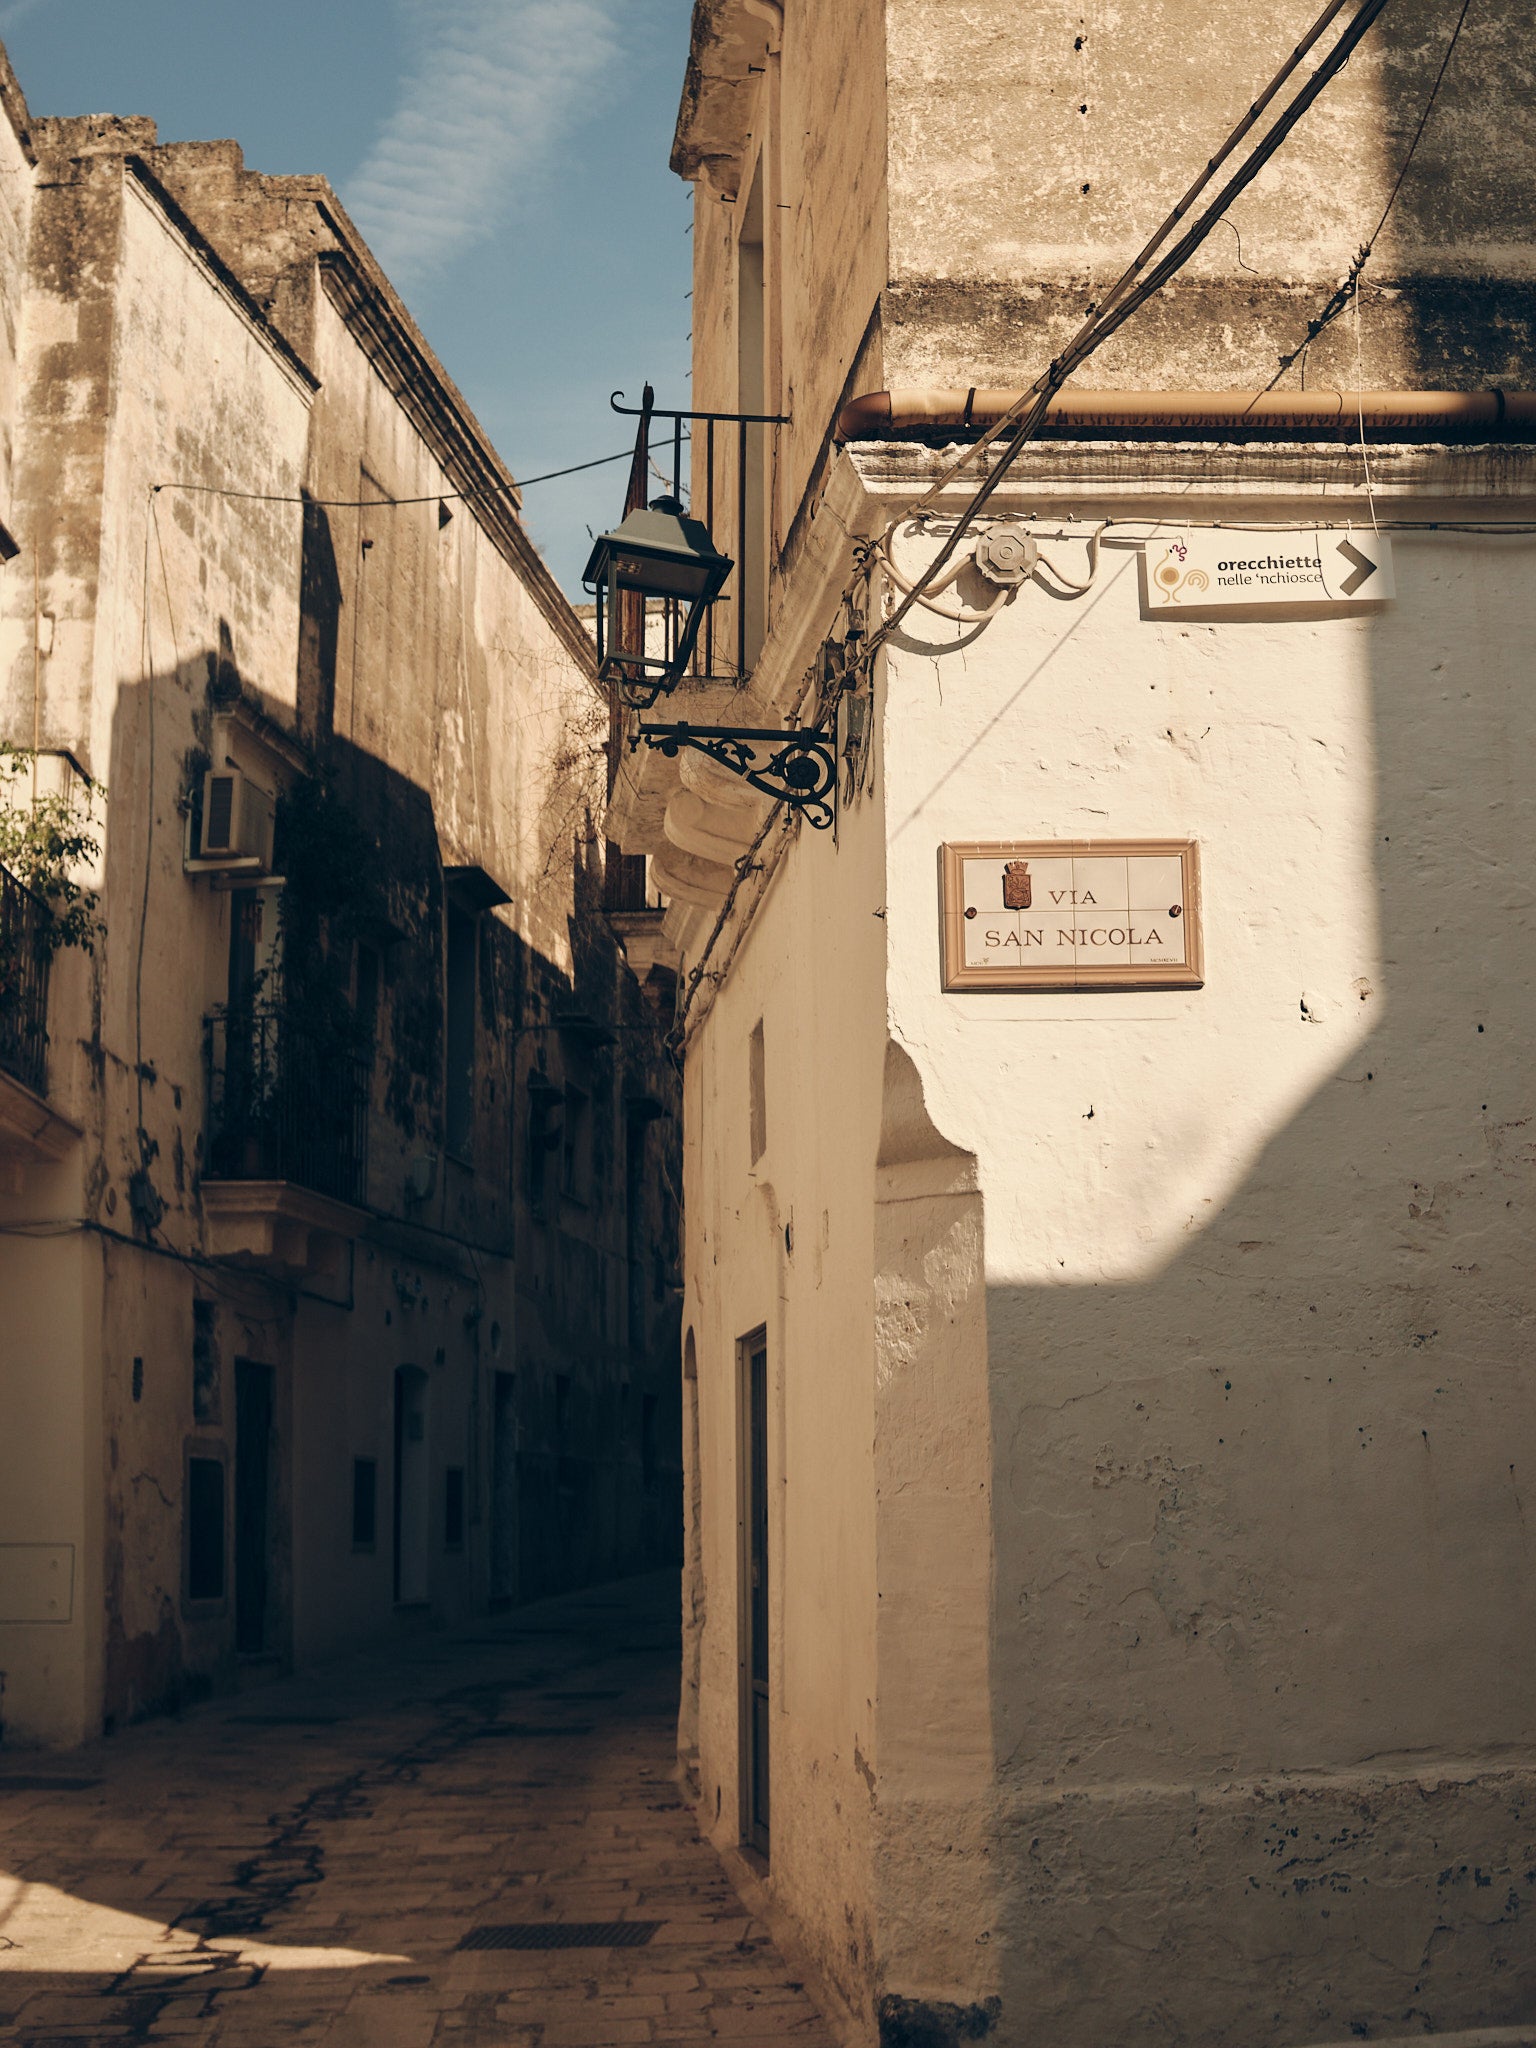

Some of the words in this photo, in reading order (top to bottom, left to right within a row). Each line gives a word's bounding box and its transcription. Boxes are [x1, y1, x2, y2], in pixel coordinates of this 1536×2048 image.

[1217, 555, 1322, 571] orecchiette
[1217, 573, 1252, 586] nelle
[1048, 890, 1098, 905] VIA
[984, 930, 1045, 947] SAN
[1056, 928, 1164, 946] NICOLA
